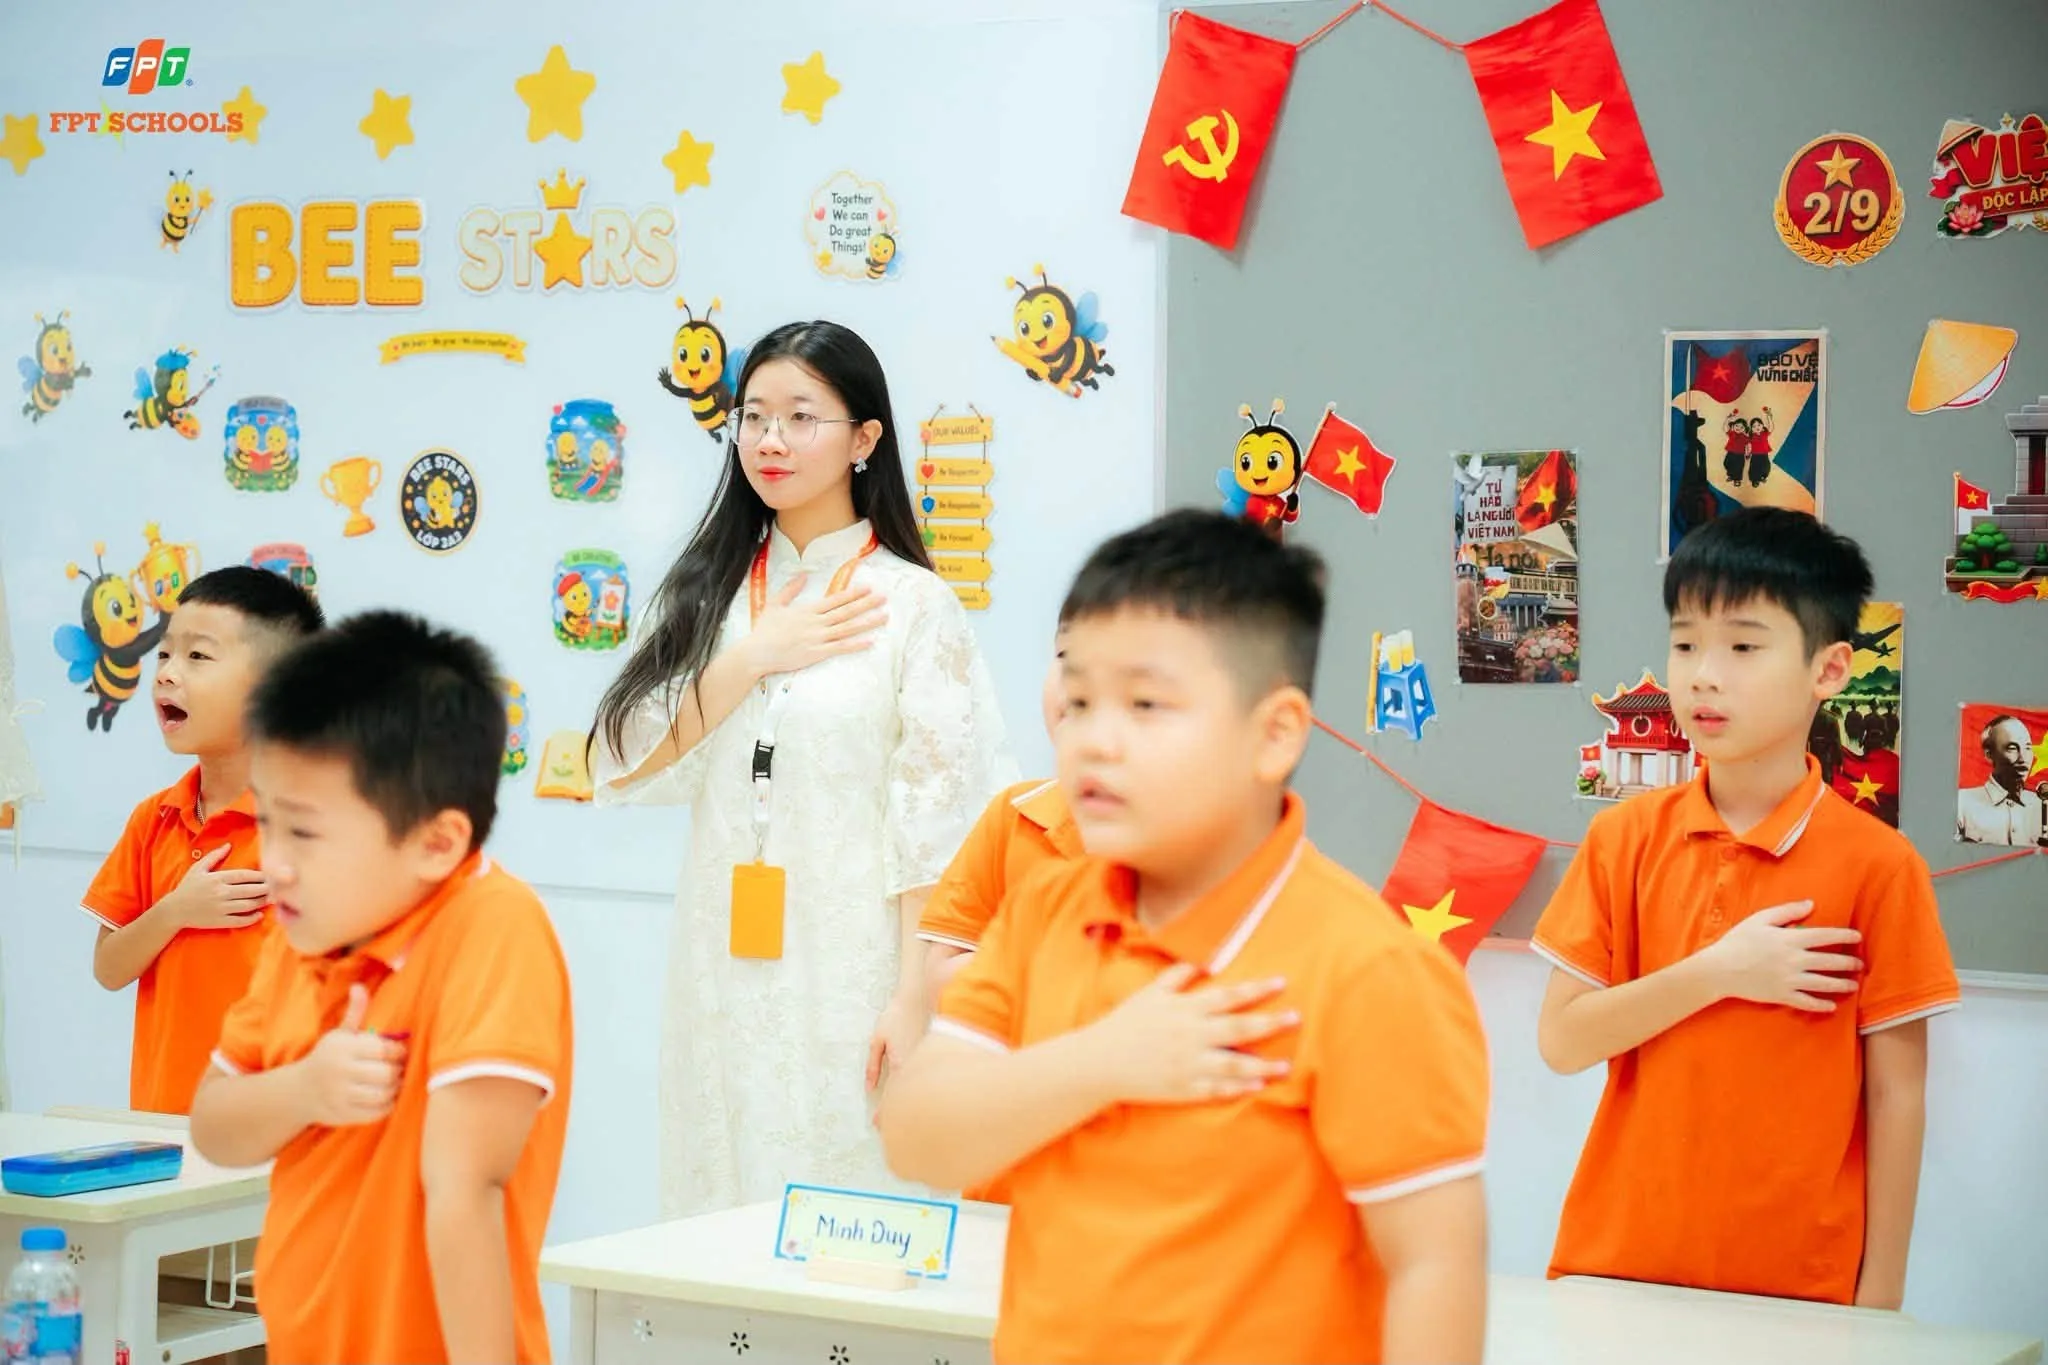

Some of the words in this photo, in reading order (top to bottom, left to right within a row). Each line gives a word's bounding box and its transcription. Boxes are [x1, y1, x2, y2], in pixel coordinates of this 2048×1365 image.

[831, 192, 874, 207] Together
[1982, 191, 2015, 211] ĐỘC
[832, 209, 849, 221] We
[850, 212, 869, 221] can
[1804, 189, 1880, 235] 2/9
[829, 224, 844, 236] Do
[845, 225, 873, 240] great
[231, 201, 424, 308] BEE
[409, 457, 433, 482] BEE
[434, 455, 471, 485] STARS
[1493, 525, 1515, 538] NAM
[816, 1214, 864, 1241] Minh
[871, 1219, 912, 1259] Duy
